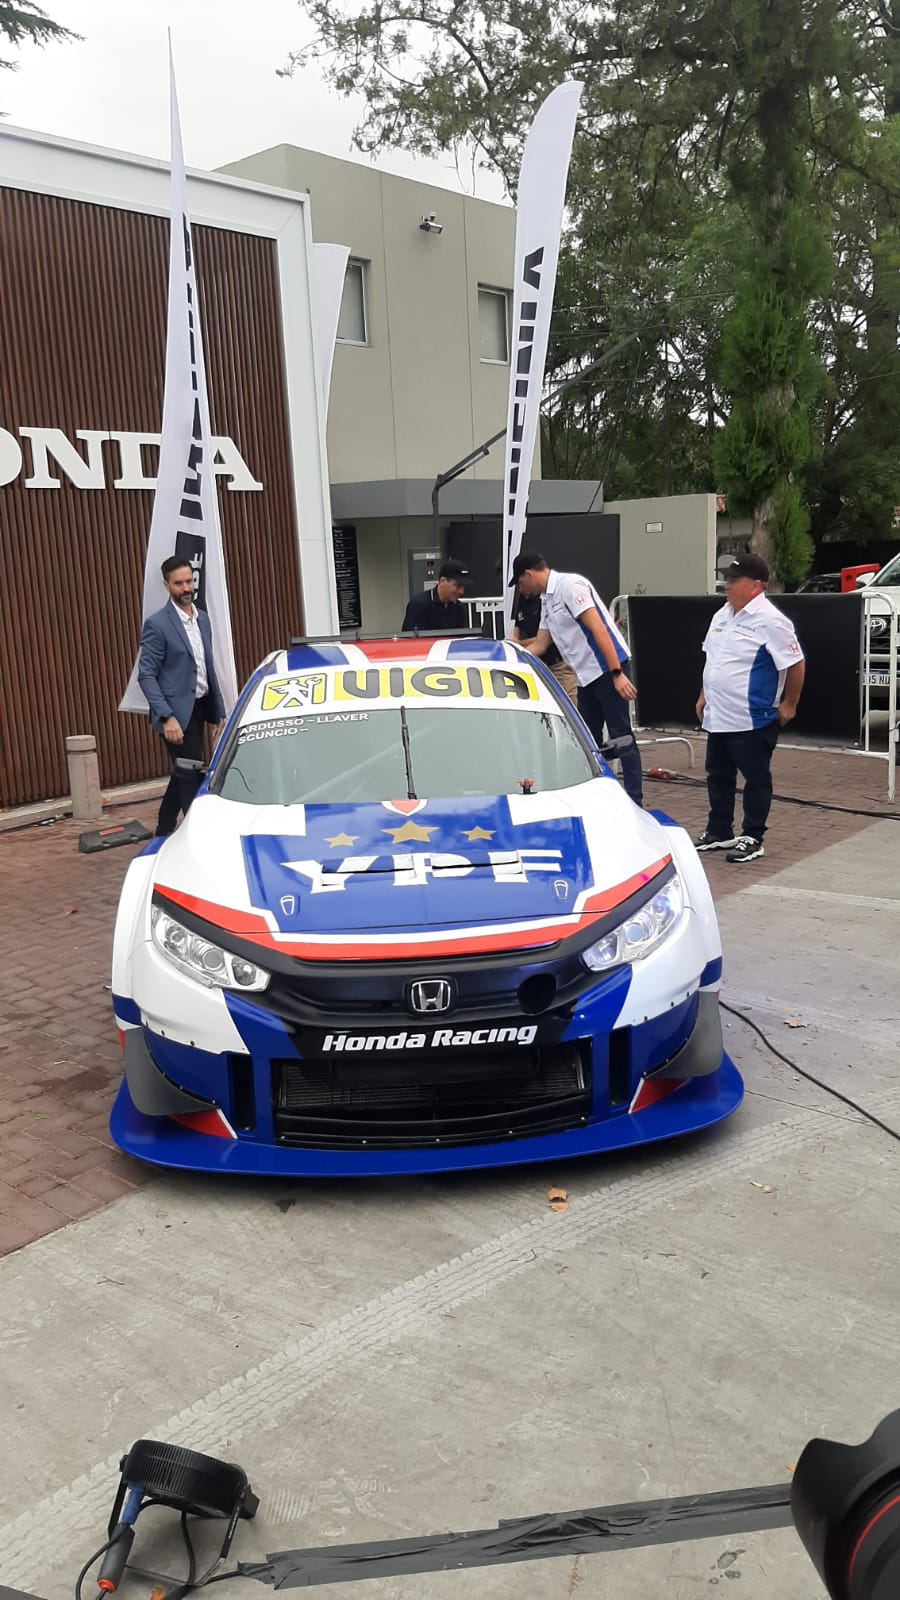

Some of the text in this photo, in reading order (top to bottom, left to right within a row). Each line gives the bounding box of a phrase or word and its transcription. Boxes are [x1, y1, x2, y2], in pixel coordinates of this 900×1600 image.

[238, 728, 298, 744] SCUNCIO
[240, 719, 304, 735] ARDUSSO
[317, 713, 369, 724] LLAVER
[280, 849, 563, 894] YPF
[322, 1025, 538, 1051] Honda Racing
